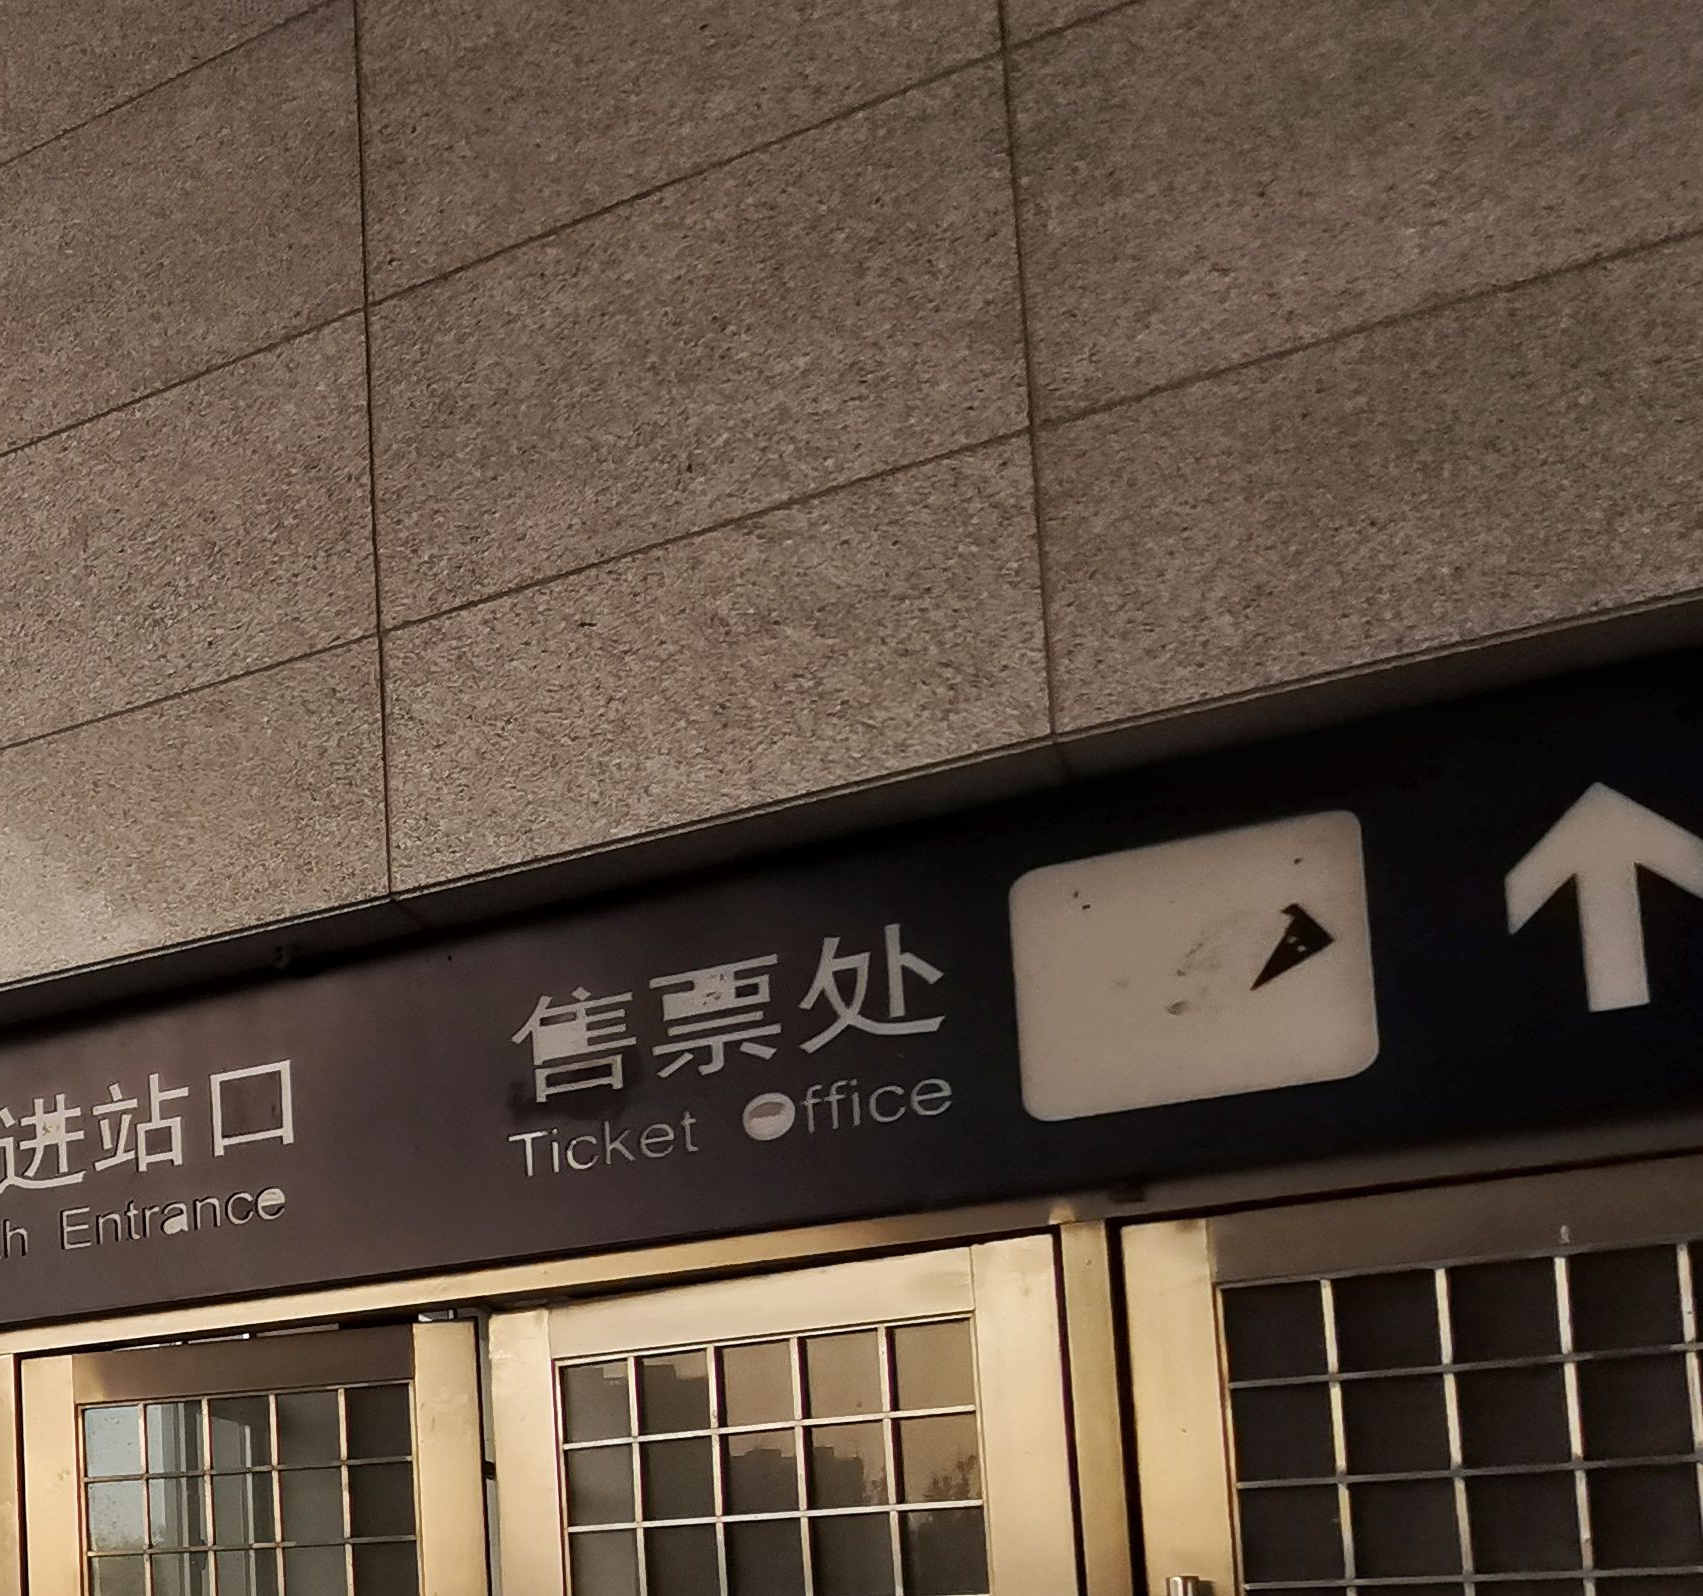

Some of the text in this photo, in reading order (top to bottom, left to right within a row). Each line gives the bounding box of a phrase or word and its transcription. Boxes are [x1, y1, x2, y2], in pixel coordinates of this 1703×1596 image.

[511, 924, 947, 1103] 售票处
[509, 1075, 954, 1178] Ticket Office
[60, 1184, 287, 1250] Entrance
